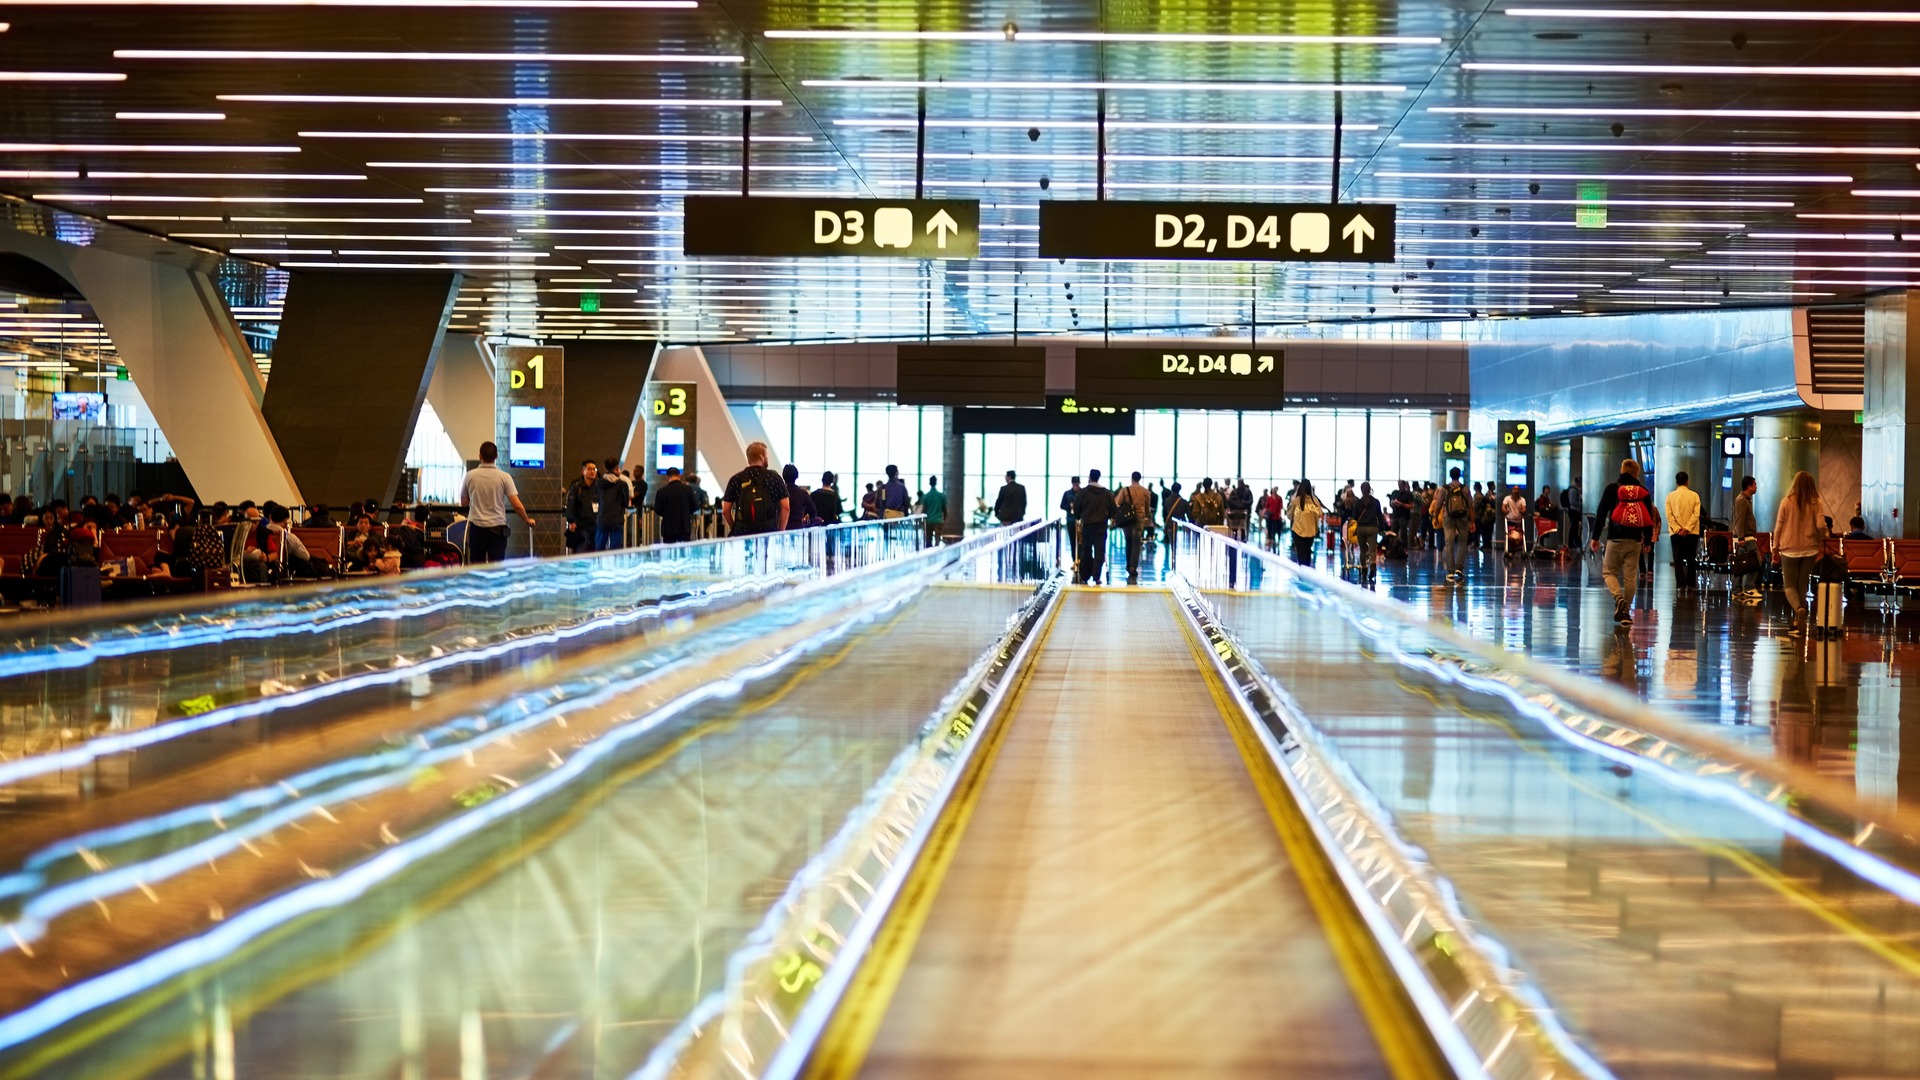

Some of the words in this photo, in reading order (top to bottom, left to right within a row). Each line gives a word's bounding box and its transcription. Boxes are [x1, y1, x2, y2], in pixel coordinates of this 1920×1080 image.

[815, 211, 865, 244] D3
[1156, 214, 1218, 253] D2,
[1227, 215, 1280, 249] D4
[1162, 355, 1195, 375] D2,
[1199, 355, 1226, 373] D4
